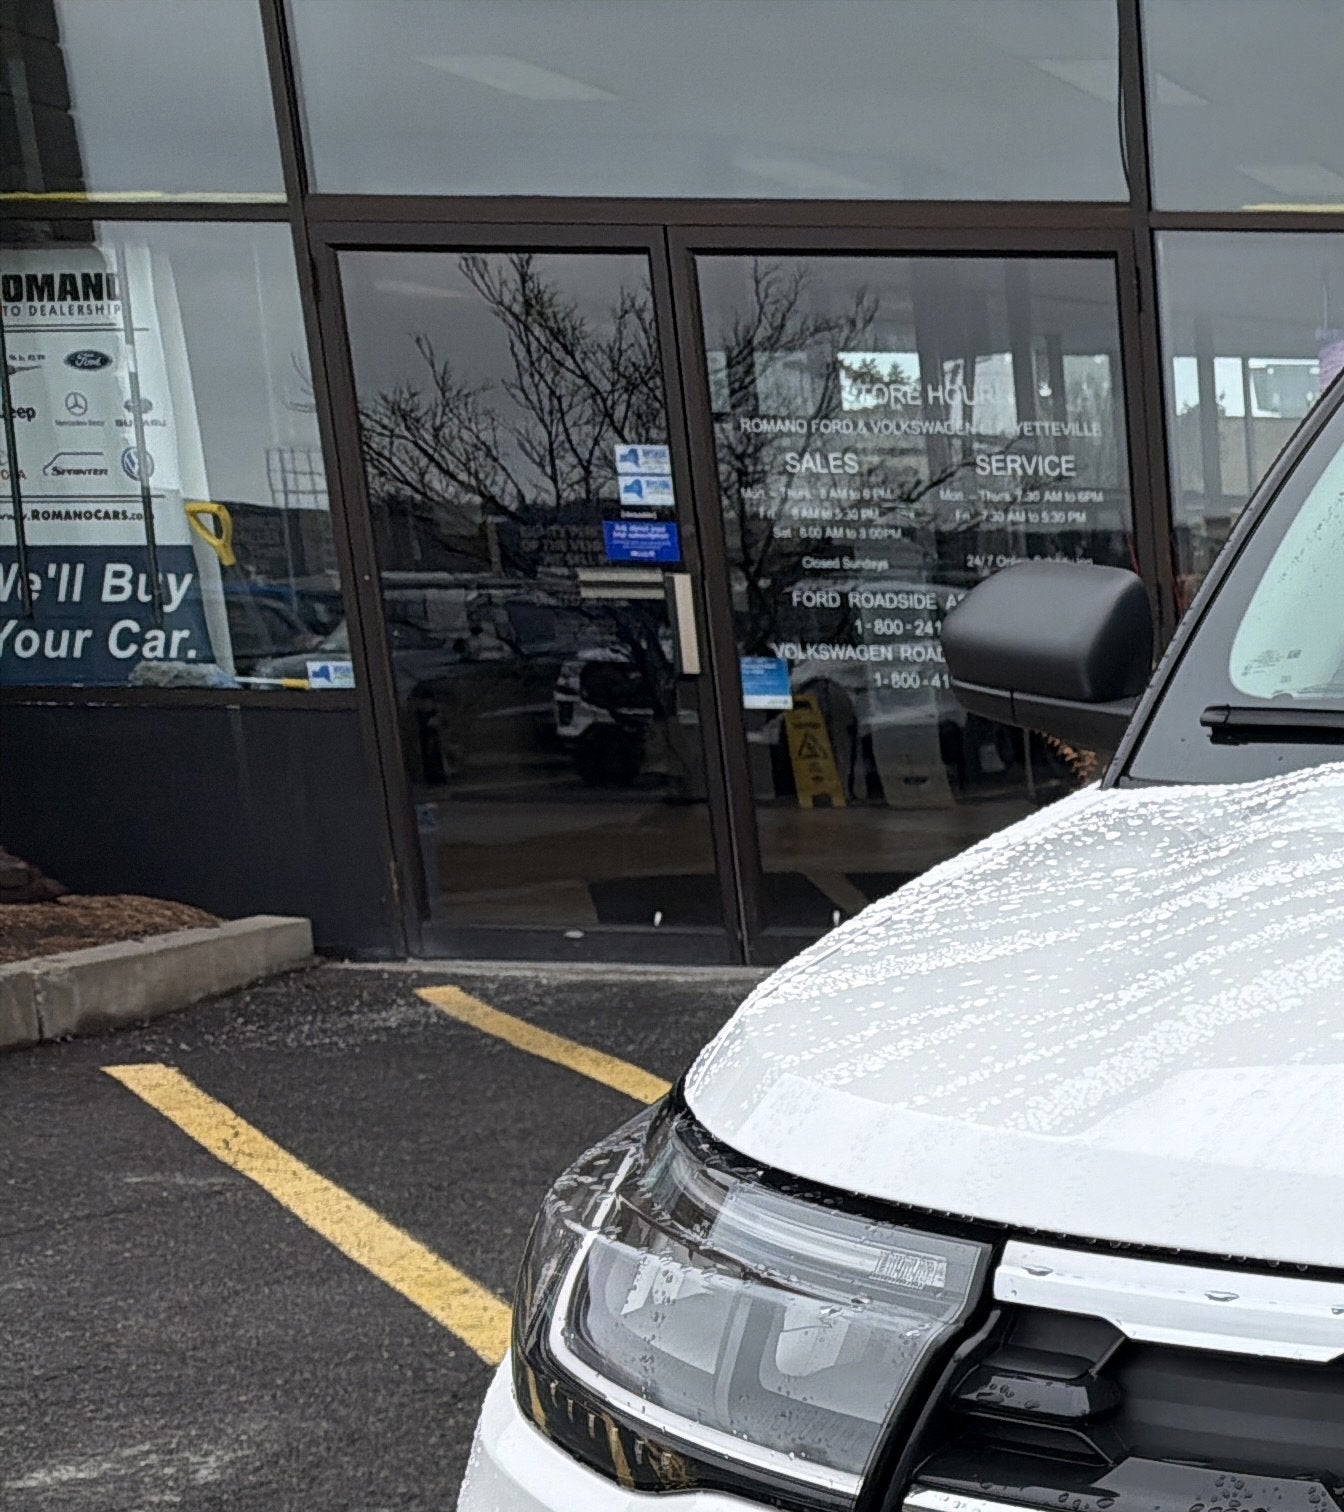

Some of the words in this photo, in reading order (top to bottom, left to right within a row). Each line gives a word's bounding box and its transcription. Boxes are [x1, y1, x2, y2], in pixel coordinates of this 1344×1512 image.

[0, 273, 121, 302] OMANO
[2, 305, 21, 317] TO
[846, 383, 923, 405] TORE
[927, 384, 1004, 405] HOUR
[115, 419, 166, 428] SUARU
[739, 417, 808, 434] ROMANO
[811, 419, 852, 434] FORD
[856, 419, 868, 434] &
[870, 419, 976, 437] VOLKSWAGEN
[999, 420, 1102, 438] YETTEVILLE
[785, 451, 860, 475] SALES
[975, 453, 1077, 477] SERVICE
[0, 509, 155, 522] w.ROMANOCARS.co
[801, 555, 841, 570] Closed
[842, 555, 890, 572] Sundays
[101, 562, 193, 613] Buy
[791, 590, 841, 608] FORD
[848, 591, 938, 610] ROADSIDE
[854, 618, 943, 636] 1-800-241
[108, 619, 197, 659] Car.
[773, 642, 893, 662] VOLKSWAGEN
[873, 671, 950, 689] 1-800-41
